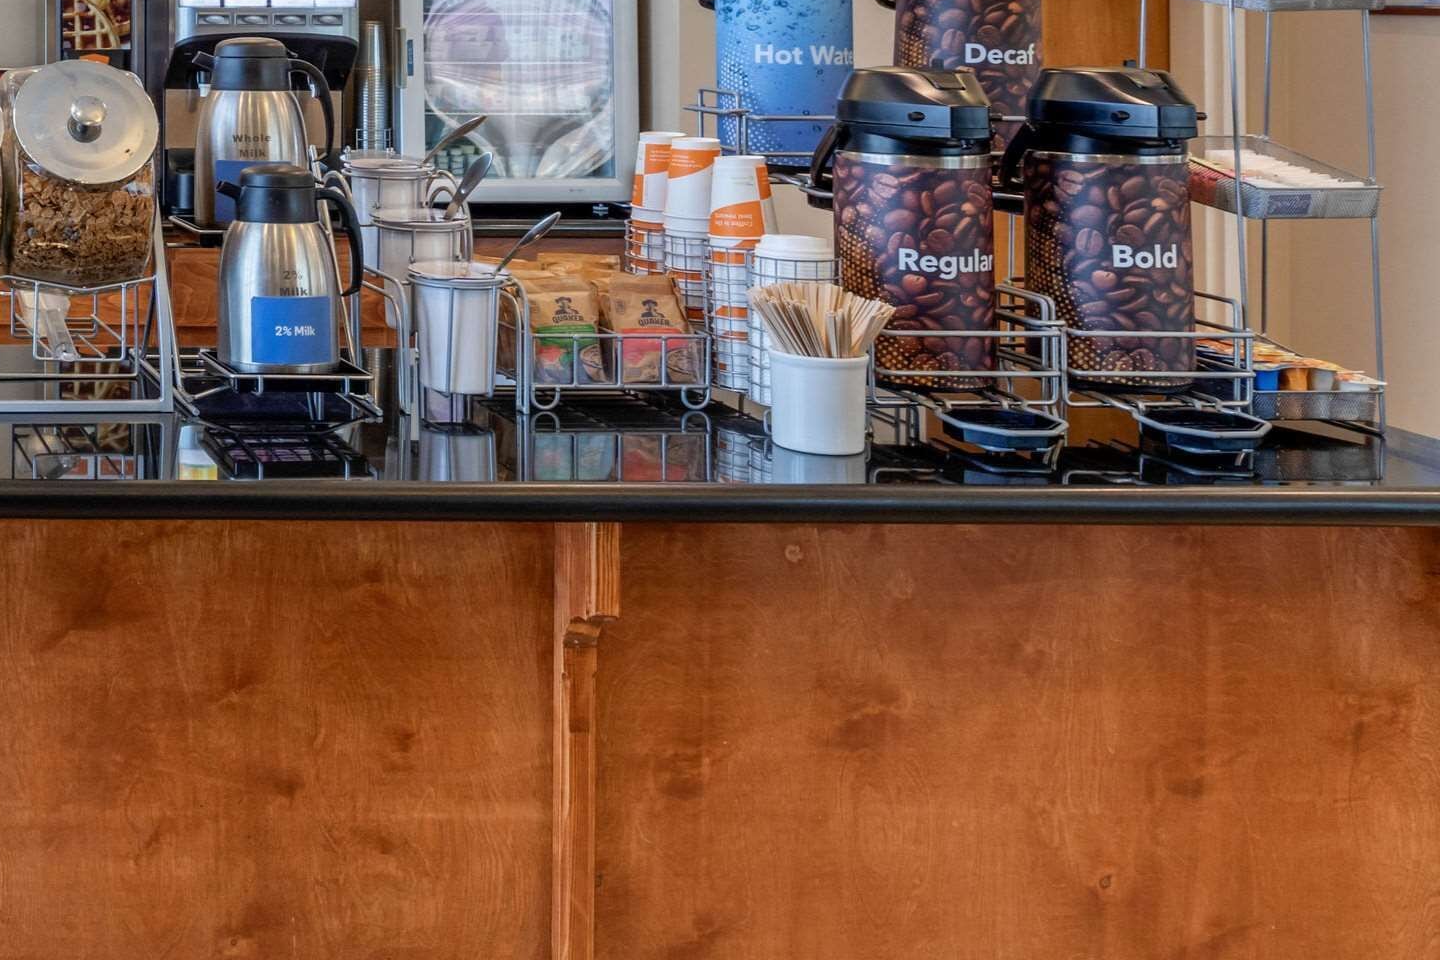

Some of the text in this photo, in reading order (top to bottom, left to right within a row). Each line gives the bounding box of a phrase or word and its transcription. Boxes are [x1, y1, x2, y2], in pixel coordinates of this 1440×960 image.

[754, 44, 853, 65] Hot Wate
[964, 43, 1035, 65] Decaf
[232, 134, 272, 143] Whole
[240, 149, 266, 159] Milk
[1112, 244, 1177, 269] Bold
[279, 286, 308, 296] Milk
[274, 325, 316, 337] 2% Milk
